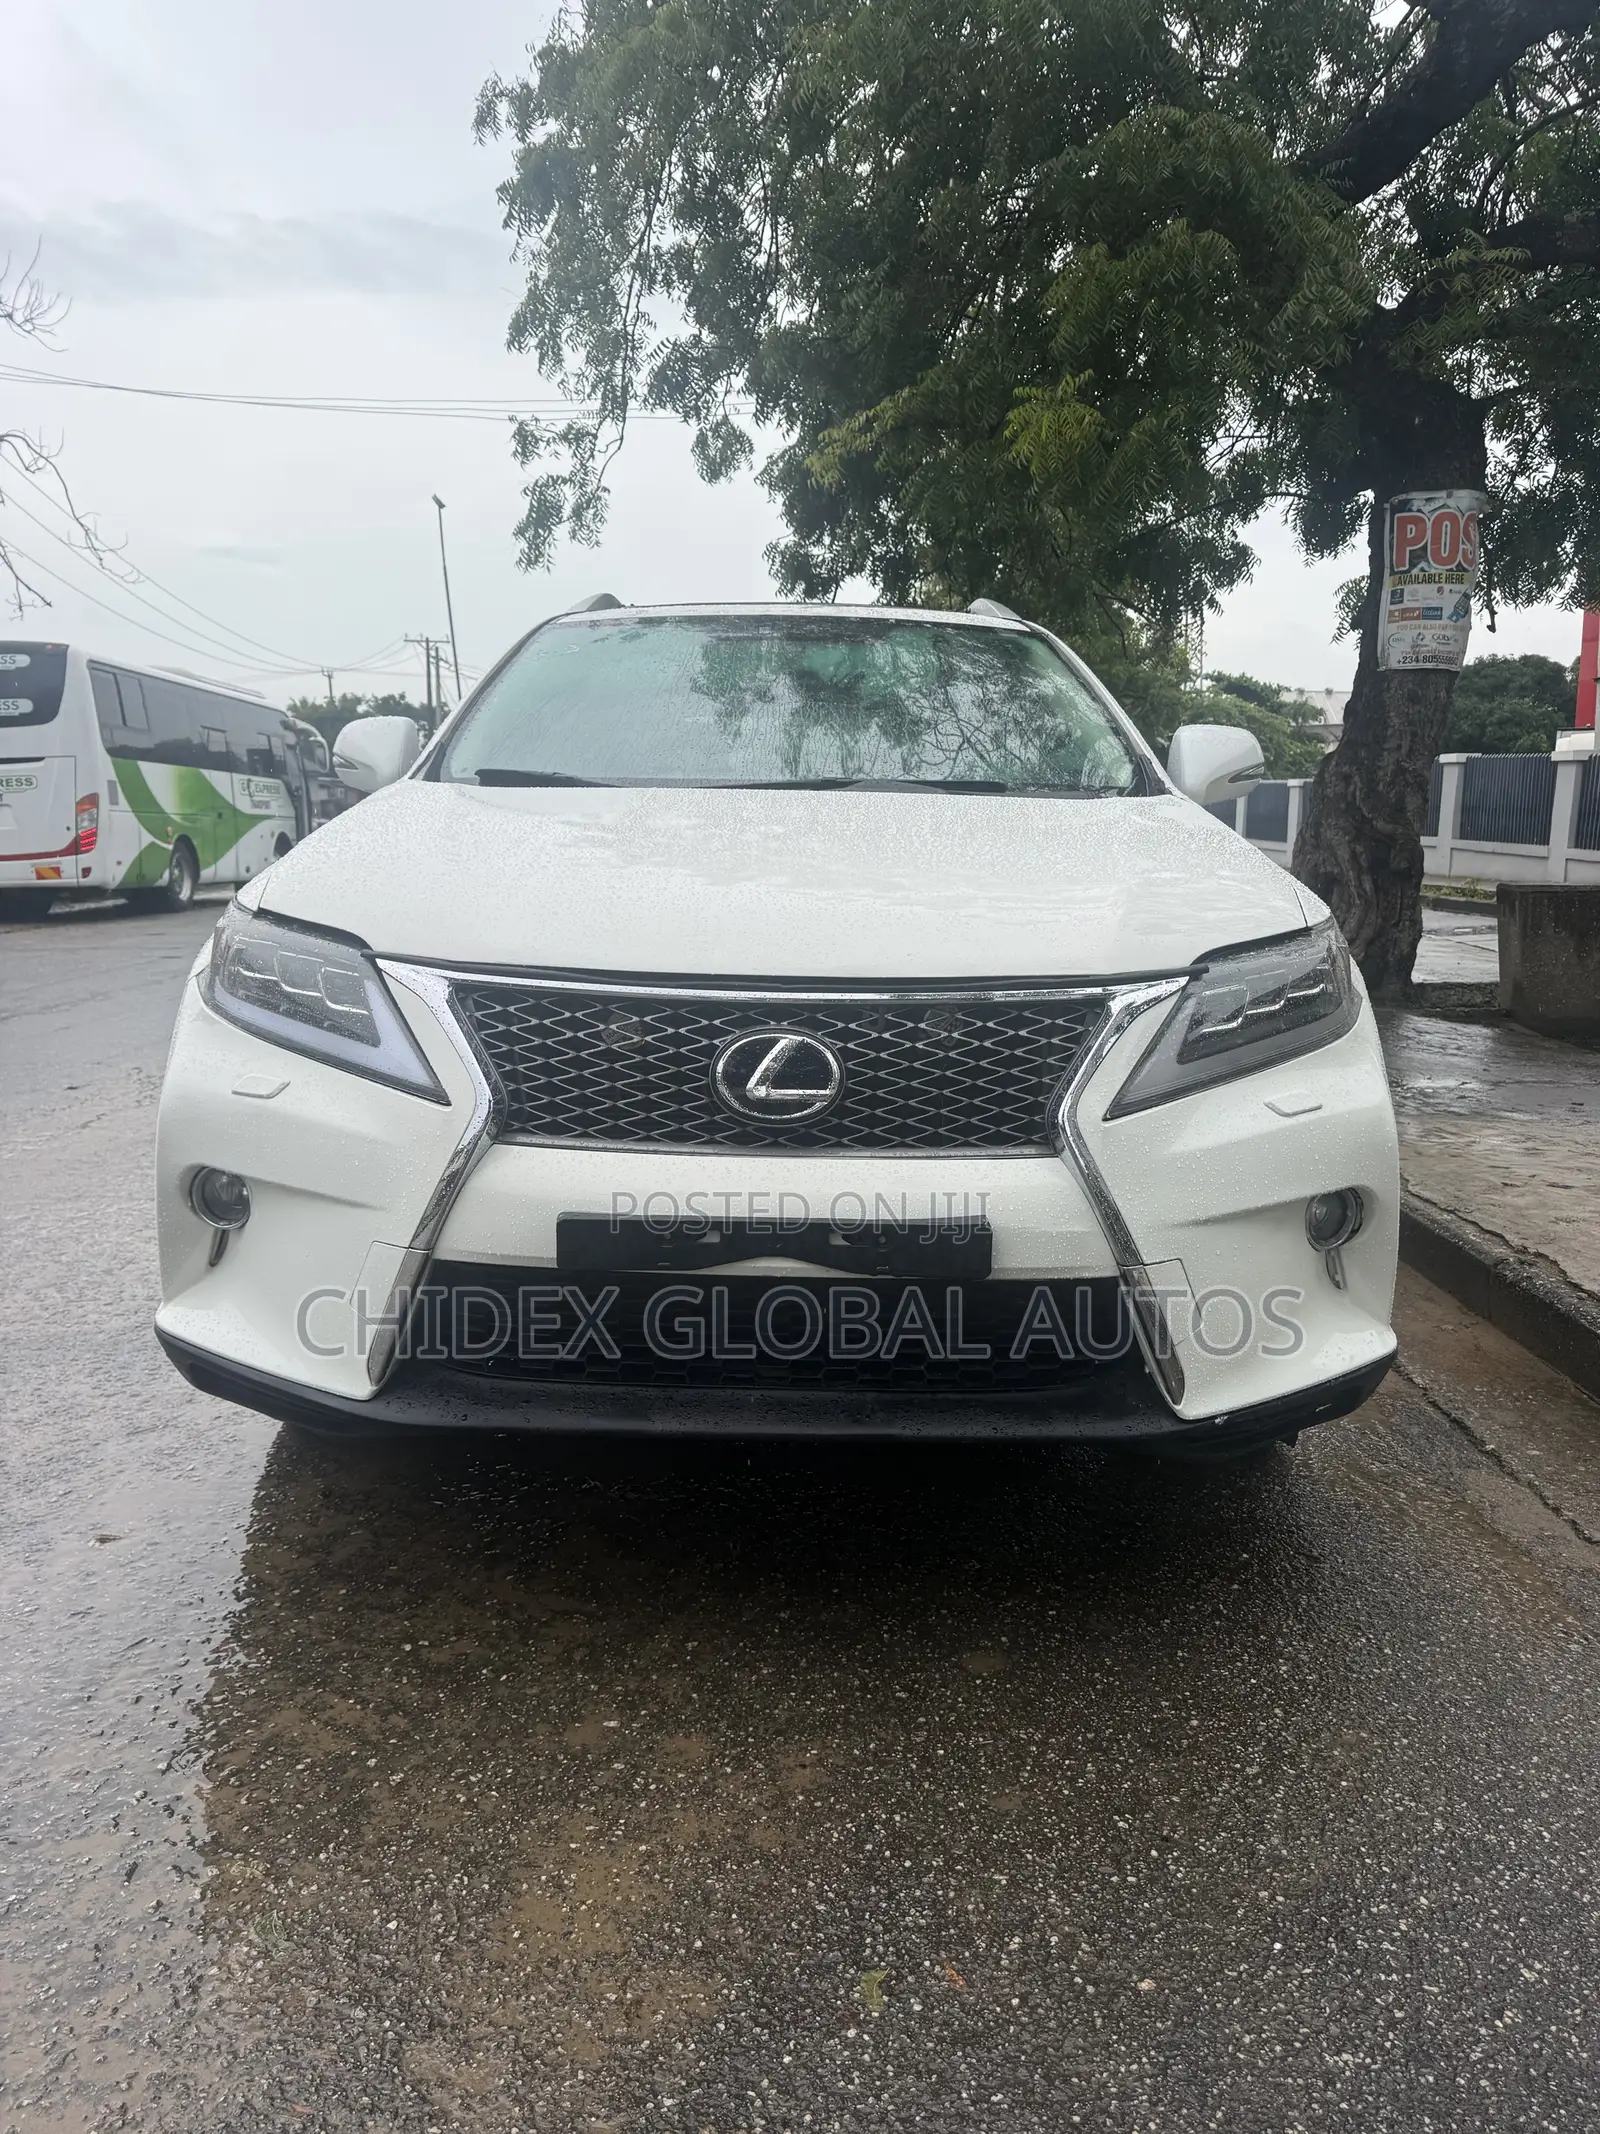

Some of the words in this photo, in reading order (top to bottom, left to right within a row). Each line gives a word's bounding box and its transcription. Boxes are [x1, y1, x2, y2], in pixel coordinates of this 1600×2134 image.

[1393, 509, 1477, 571] POS
[1397, 573, 1443, 586] AVAILABLE
[1445, 573, 1465, 585] HERE
[1397, 655, 1419, 665] +234
